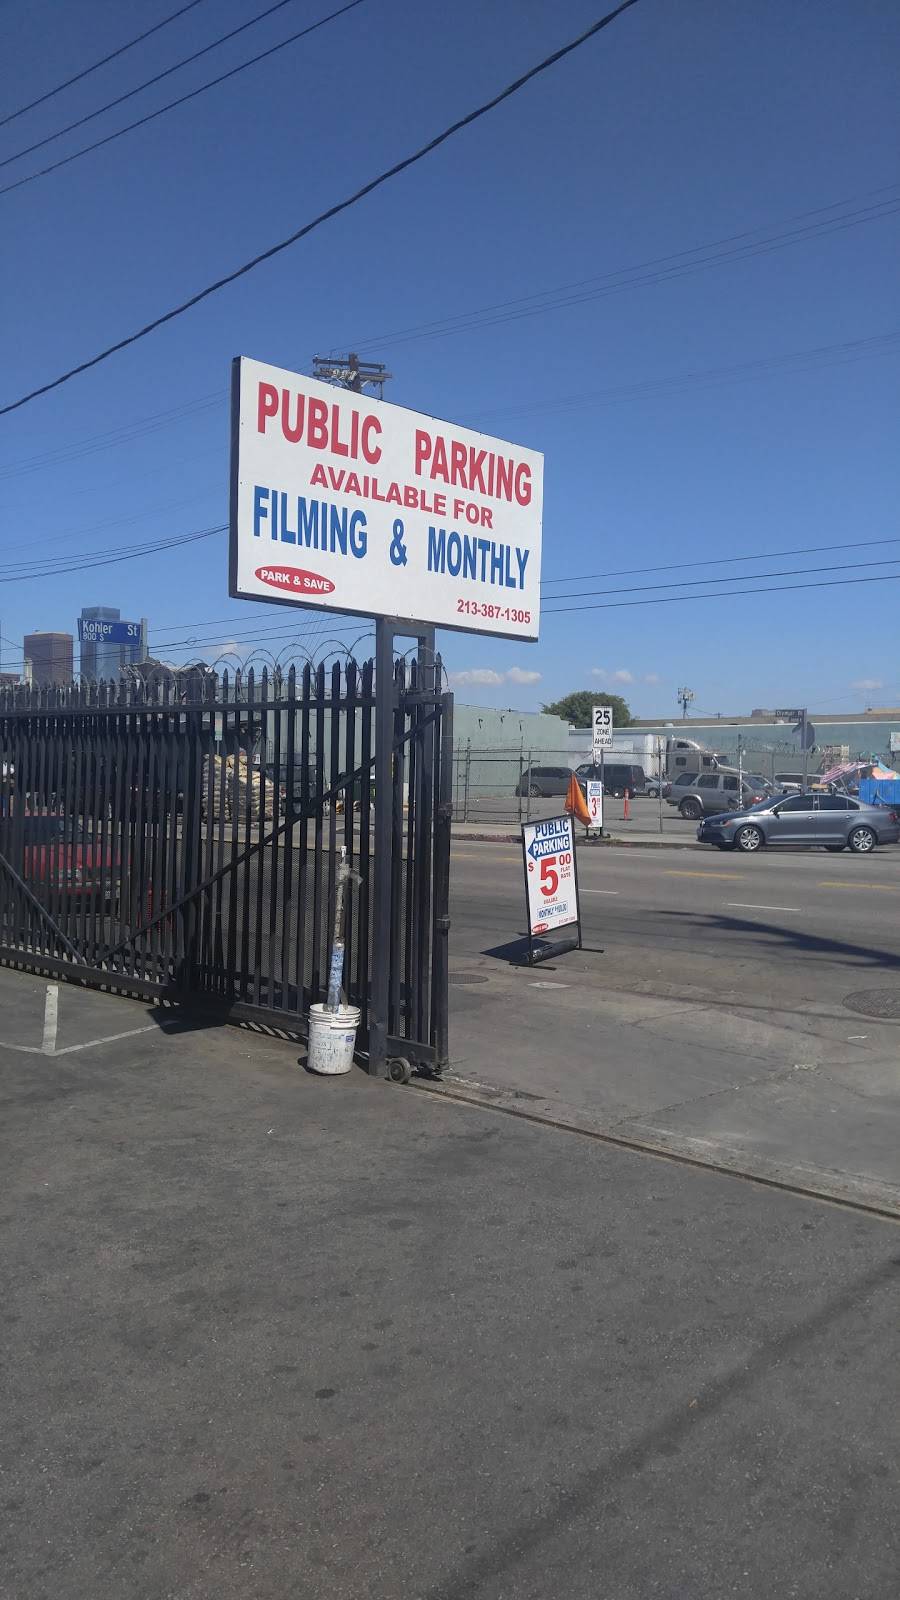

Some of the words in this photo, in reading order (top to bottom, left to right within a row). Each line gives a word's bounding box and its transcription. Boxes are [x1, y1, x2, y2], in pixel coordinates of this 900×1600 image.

[257, 381, 382, 465] PUBLIC
[414, 429, 532, 506] PARKING
[310, 463, 447, 516] AVAILABLE
[453, 499, 493, 529] FOR
[253, 485, 368, 559] FILMING
[389, 518, 408, 567] &
[427, 526, 530, 590] MONTHLY
[261, 569, 290, 584] PARK
[293, 576, 301, 585] &
[303, 578, 330, 591] SAVE
[457, 598, 531, 624] 213-387-1305
[82, 620, 112, 634] Kohler
[127, 624, 138, 636] St
[82, 632, 97, 640] 800
[595, 710, 610, 725] 25
[592, 797, 597, 816] 3
[535, 820, 569, 838] PUBLIC
[533, 836, 569, 856] PARKING
[540, 857, 559, 896] 5
[559, 853, 571, 865] 00
